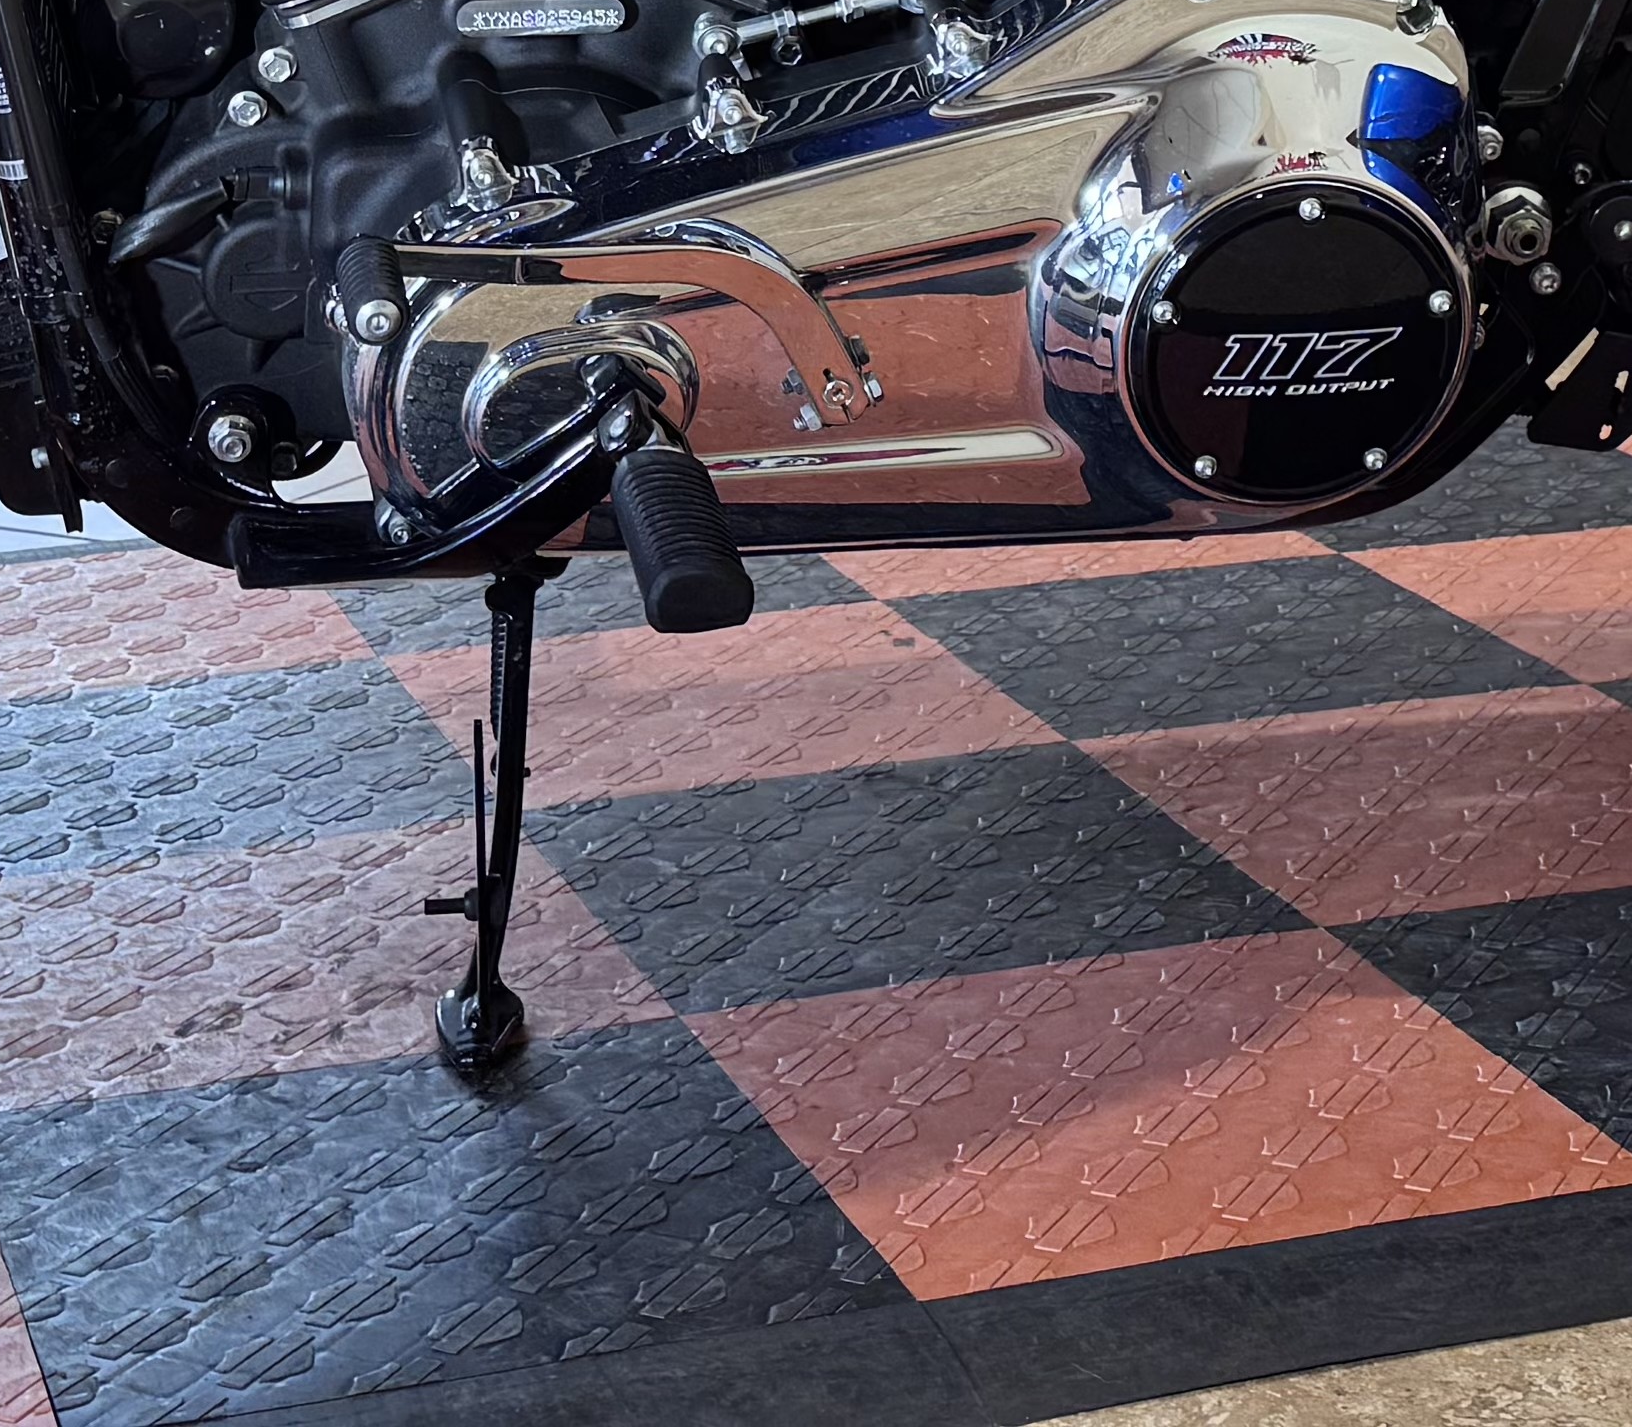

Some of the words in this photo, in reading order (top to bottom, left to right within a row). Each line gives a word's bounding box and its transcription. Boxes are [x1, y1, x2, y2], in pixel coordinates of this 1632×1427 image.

[1212, 326, 1403, 381] 117
[1203, 385, 1277, 397] HIGH
[1285, 377, 1395, 396] OUTPUT
